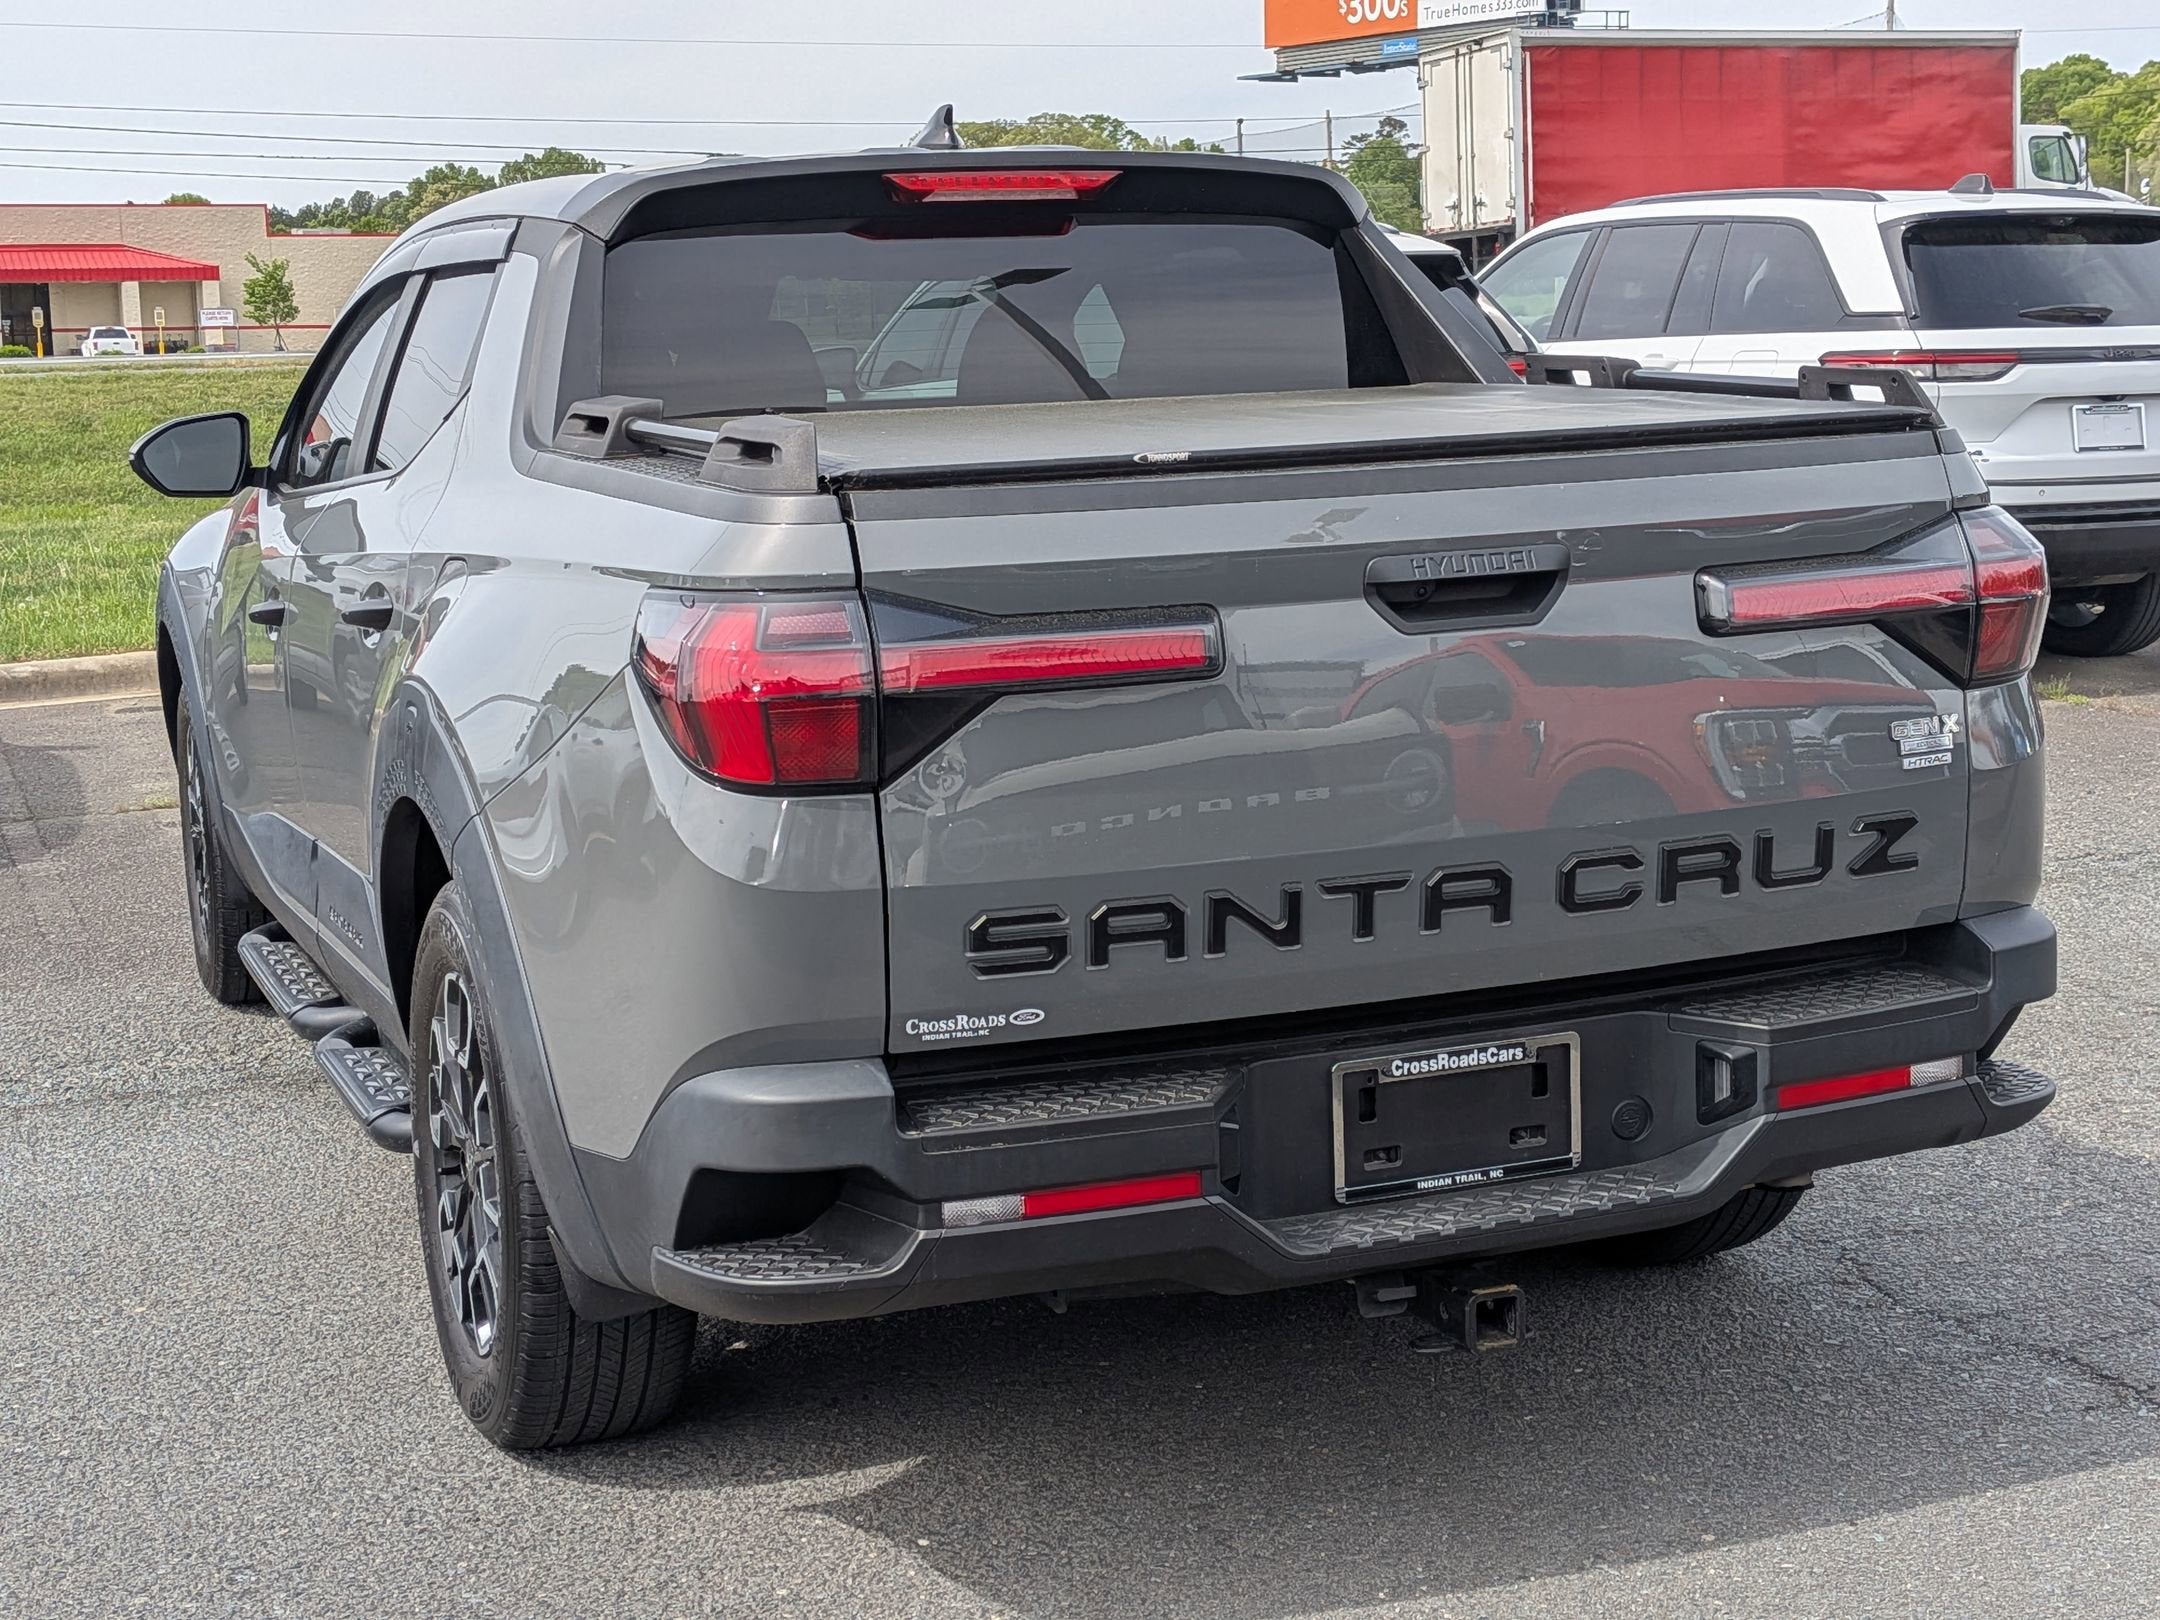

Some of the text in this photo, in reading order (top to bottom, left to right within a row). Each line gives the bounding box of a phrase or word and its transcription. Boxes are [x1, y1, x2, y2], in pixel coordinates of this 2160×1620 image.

[1424, 0, 1539, 20] TrueHomes333.com
[1411, 550, 1537, 578] HYUNDAI
[1907, 754, 1948, 767] HTRAC
[964, 809, 1920, 980] SANTA CRUZ
[922, 1032, 950, 1041] INDIAN
[1391, 1046, 1524, 1077] CrossRoadsCars
[1417, 1169, 1504, 1190] INDIAN TRAIL, NC
